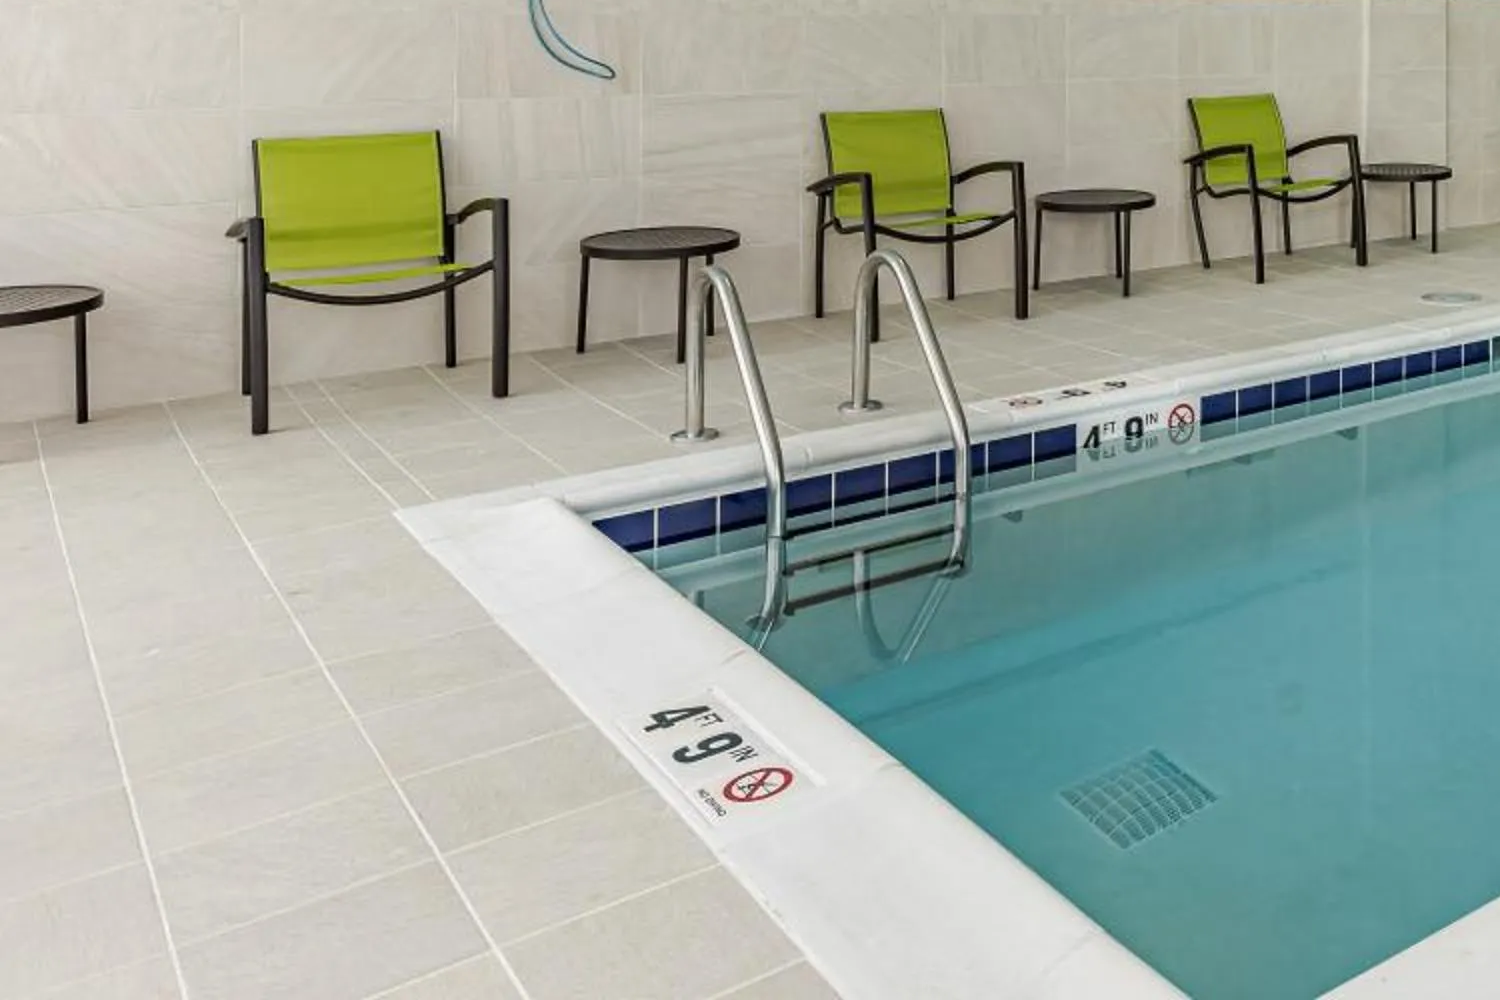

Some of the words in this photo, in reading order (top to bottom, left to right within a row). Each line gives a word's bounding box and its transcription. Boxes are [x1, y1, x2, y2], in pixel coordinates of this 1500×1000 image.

[1083, 425, 1101, 449] 4
[1103, 421, 1116, 434] FT
[1146, 412, 1159, 426] IN
[643, 705, 711, 732] 4
[696, 712, 724, 727] FT
[672, 732, 743, 763] 9
[729, 745, 759, 763] IN
